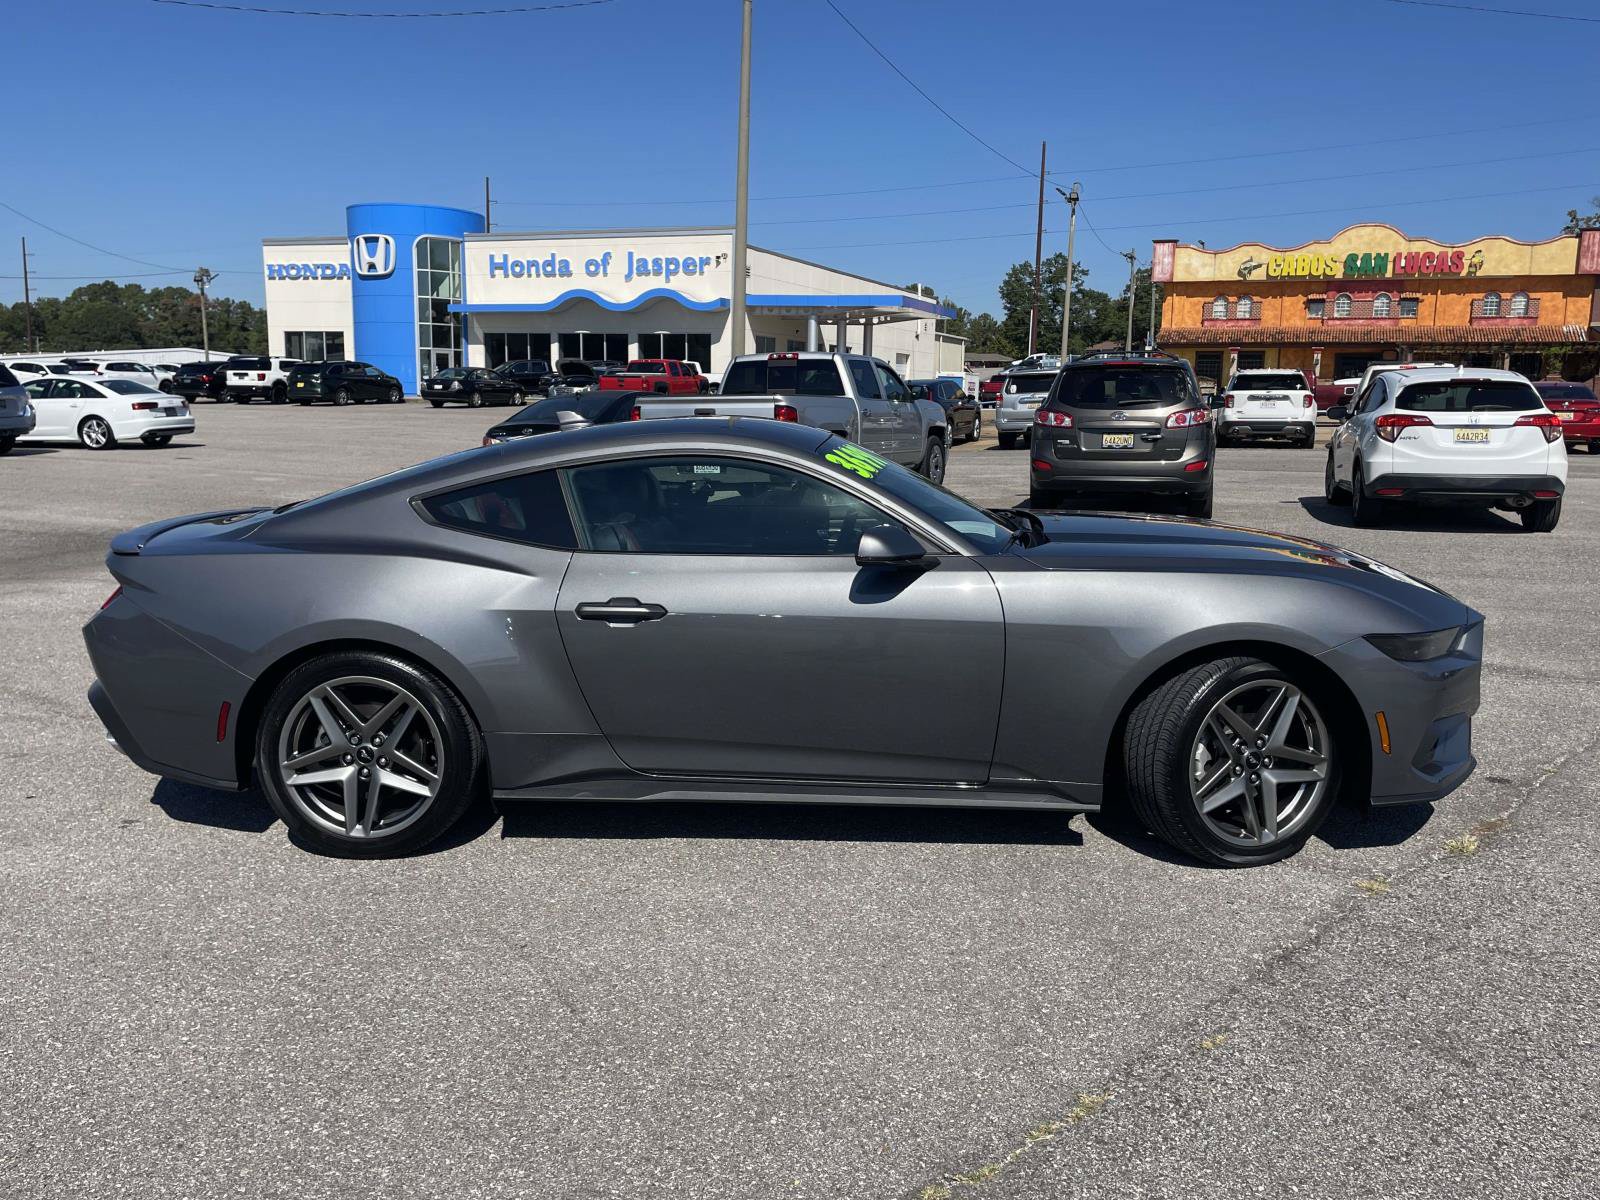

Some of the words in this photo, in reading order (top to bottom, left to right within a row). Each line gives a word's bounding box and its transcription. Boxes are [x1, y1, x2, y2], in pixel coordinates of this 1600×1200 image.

[266, 263, 351, 280] HONDA
[489, 253, 573, 278] Honda
[584, 251, 612, 277] of
[624, 251, 711, 283] Jasper
[1267, 254, 1339, 277] CABOS
[1343, 252, 1389, 275] SAN
[1393, 250, 1465, 274] LUCAS
